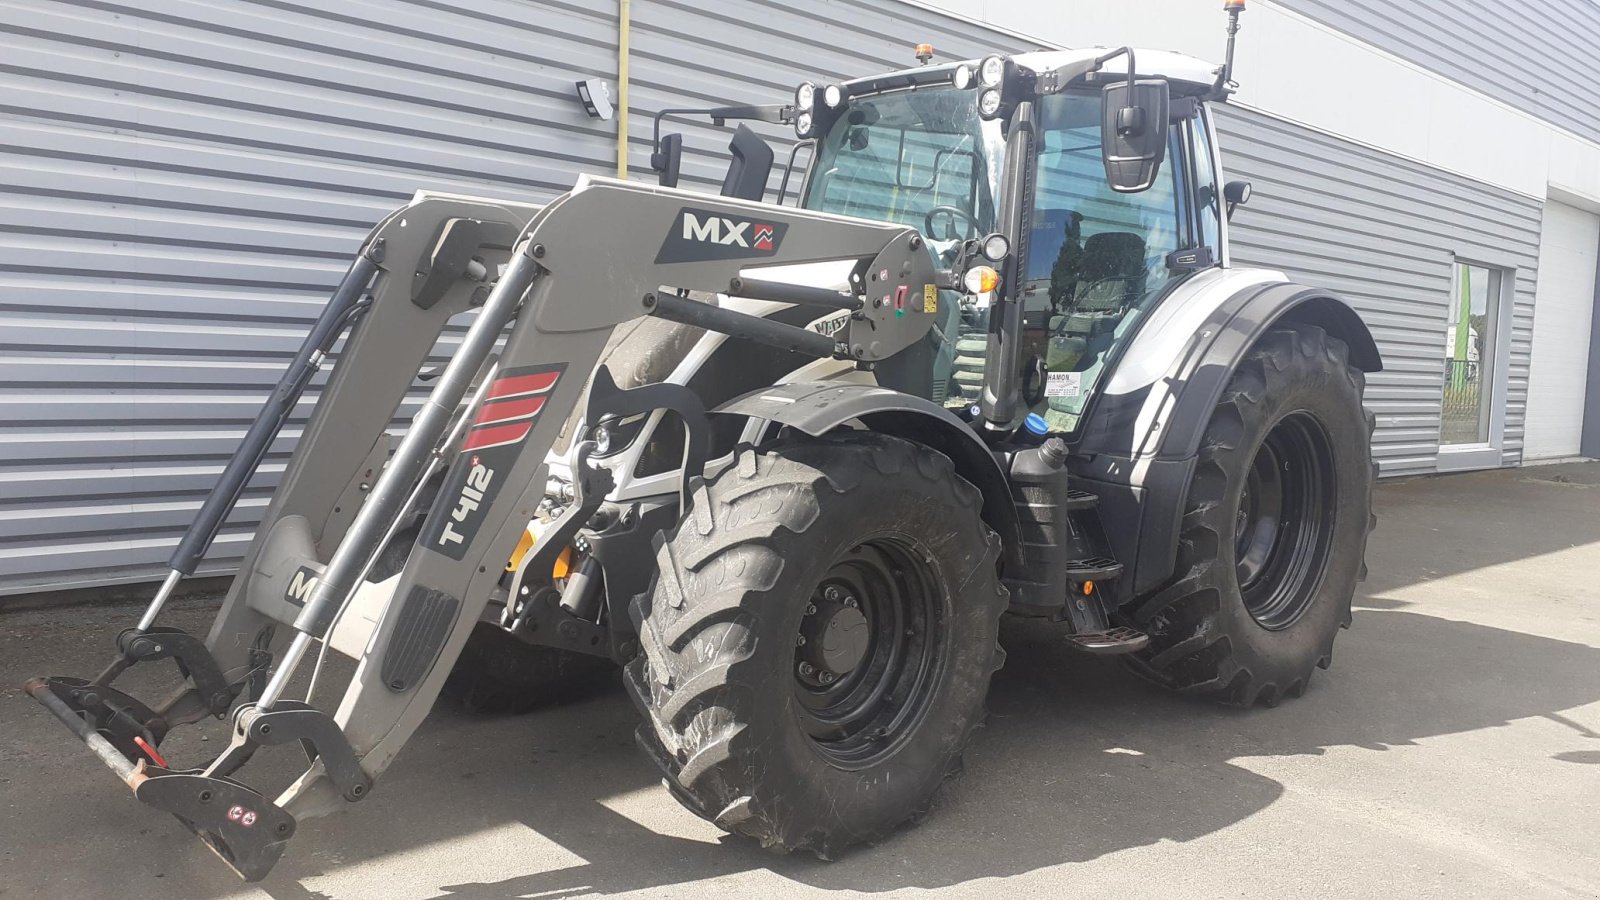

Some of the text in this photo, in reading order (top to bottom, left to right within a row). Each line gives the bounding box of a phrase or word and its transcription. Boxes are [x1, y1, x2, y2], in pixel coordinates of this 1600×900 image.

[683, 212, 751, 248] MX
[815, 315, 848, 335] VALT
[438, 463, 495, 545] T 412
[287, 571, 319, 603] M
